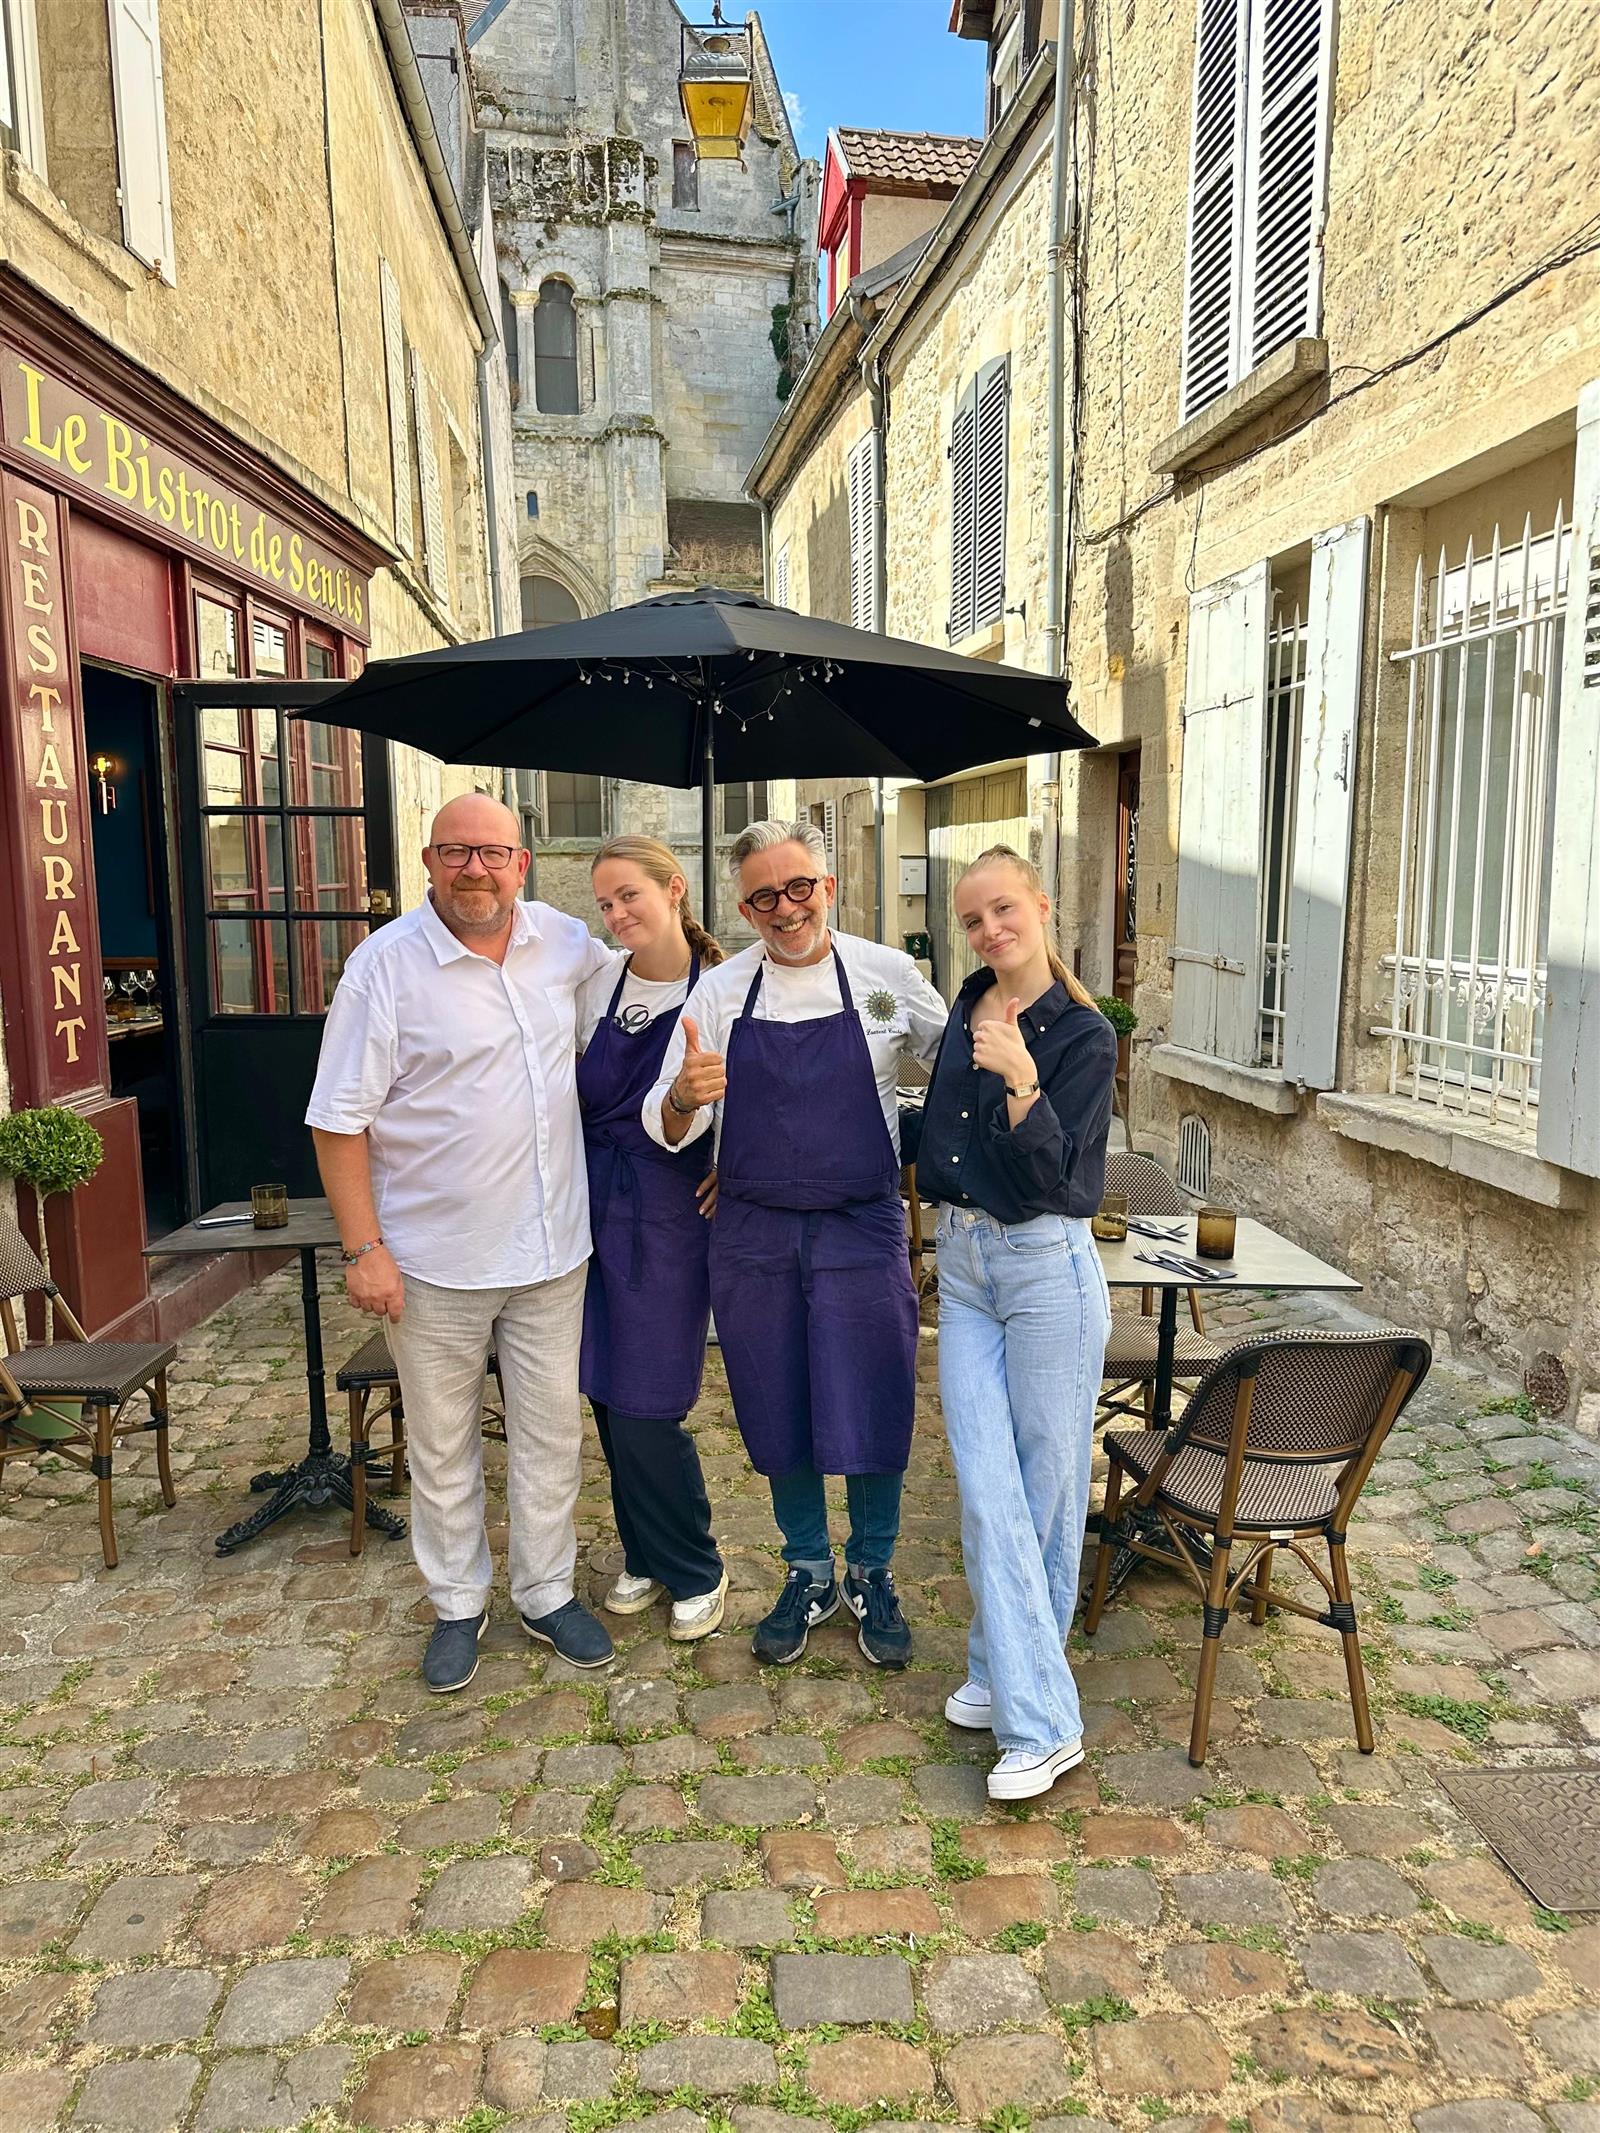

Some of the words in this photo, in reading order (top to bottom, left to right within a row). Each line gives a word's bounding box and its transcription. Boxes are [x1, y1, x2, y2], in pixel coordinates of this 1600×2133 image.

[18, 362, 93, 475] Le
[99, 412, 246, 560] Bistrot
[250, 512, 285, 580] de
[289, 533, 363, 625] Senlis
[15, 498, 87, 1064] RESTAURANT
